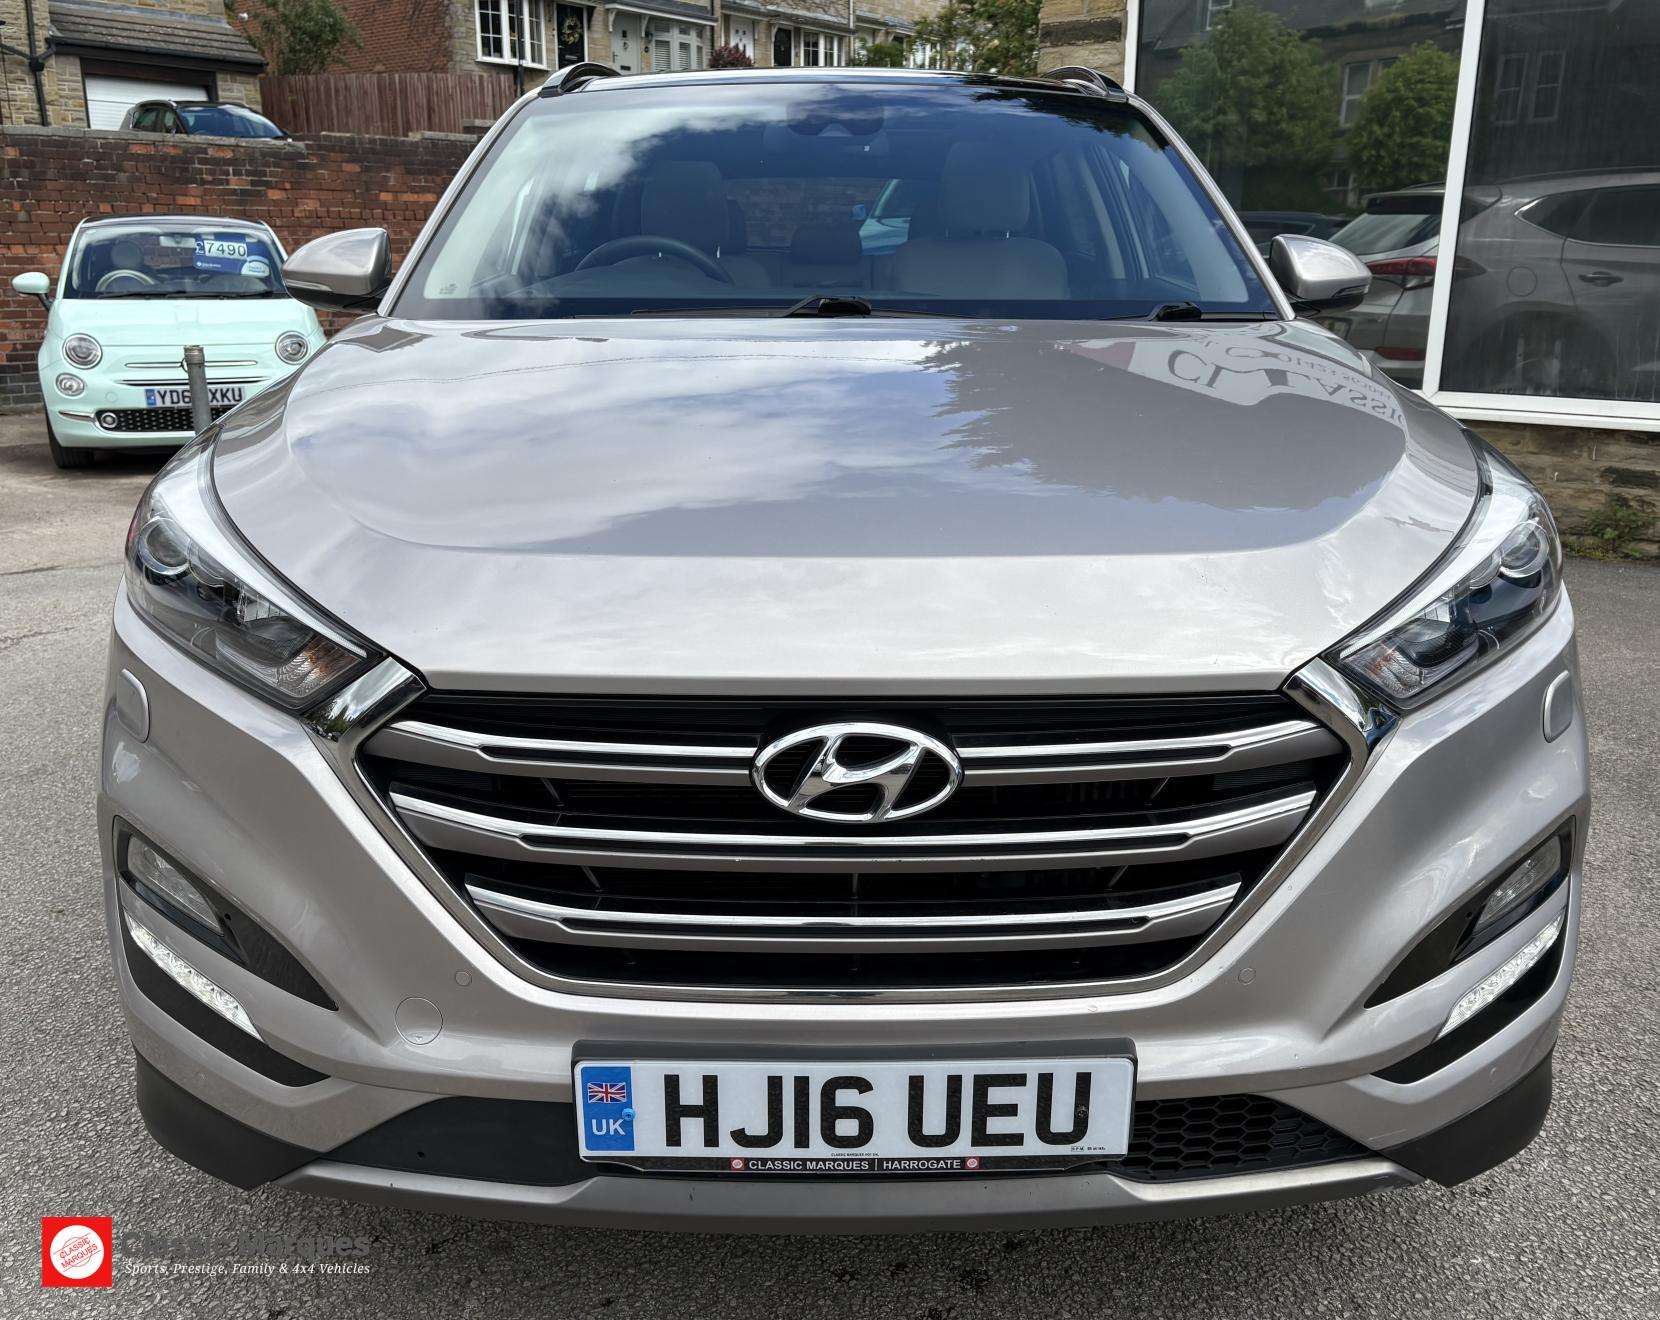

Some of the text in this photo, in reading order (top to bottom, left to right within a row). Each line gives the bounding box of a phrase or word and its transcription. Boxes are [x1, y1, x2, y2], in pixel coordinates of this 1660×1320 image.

[157, 388, 243, 406] YD6 XKU
[663, 1072, 1092, 1149] HJ16 UEU
[591, 1118, 626, 1136] UK
[749, 1160, 802, 1170] CLASSIC
[806, 1160, 869, 1170] MARQUES
[883, 1159, 961, 1169] HARROGATE
